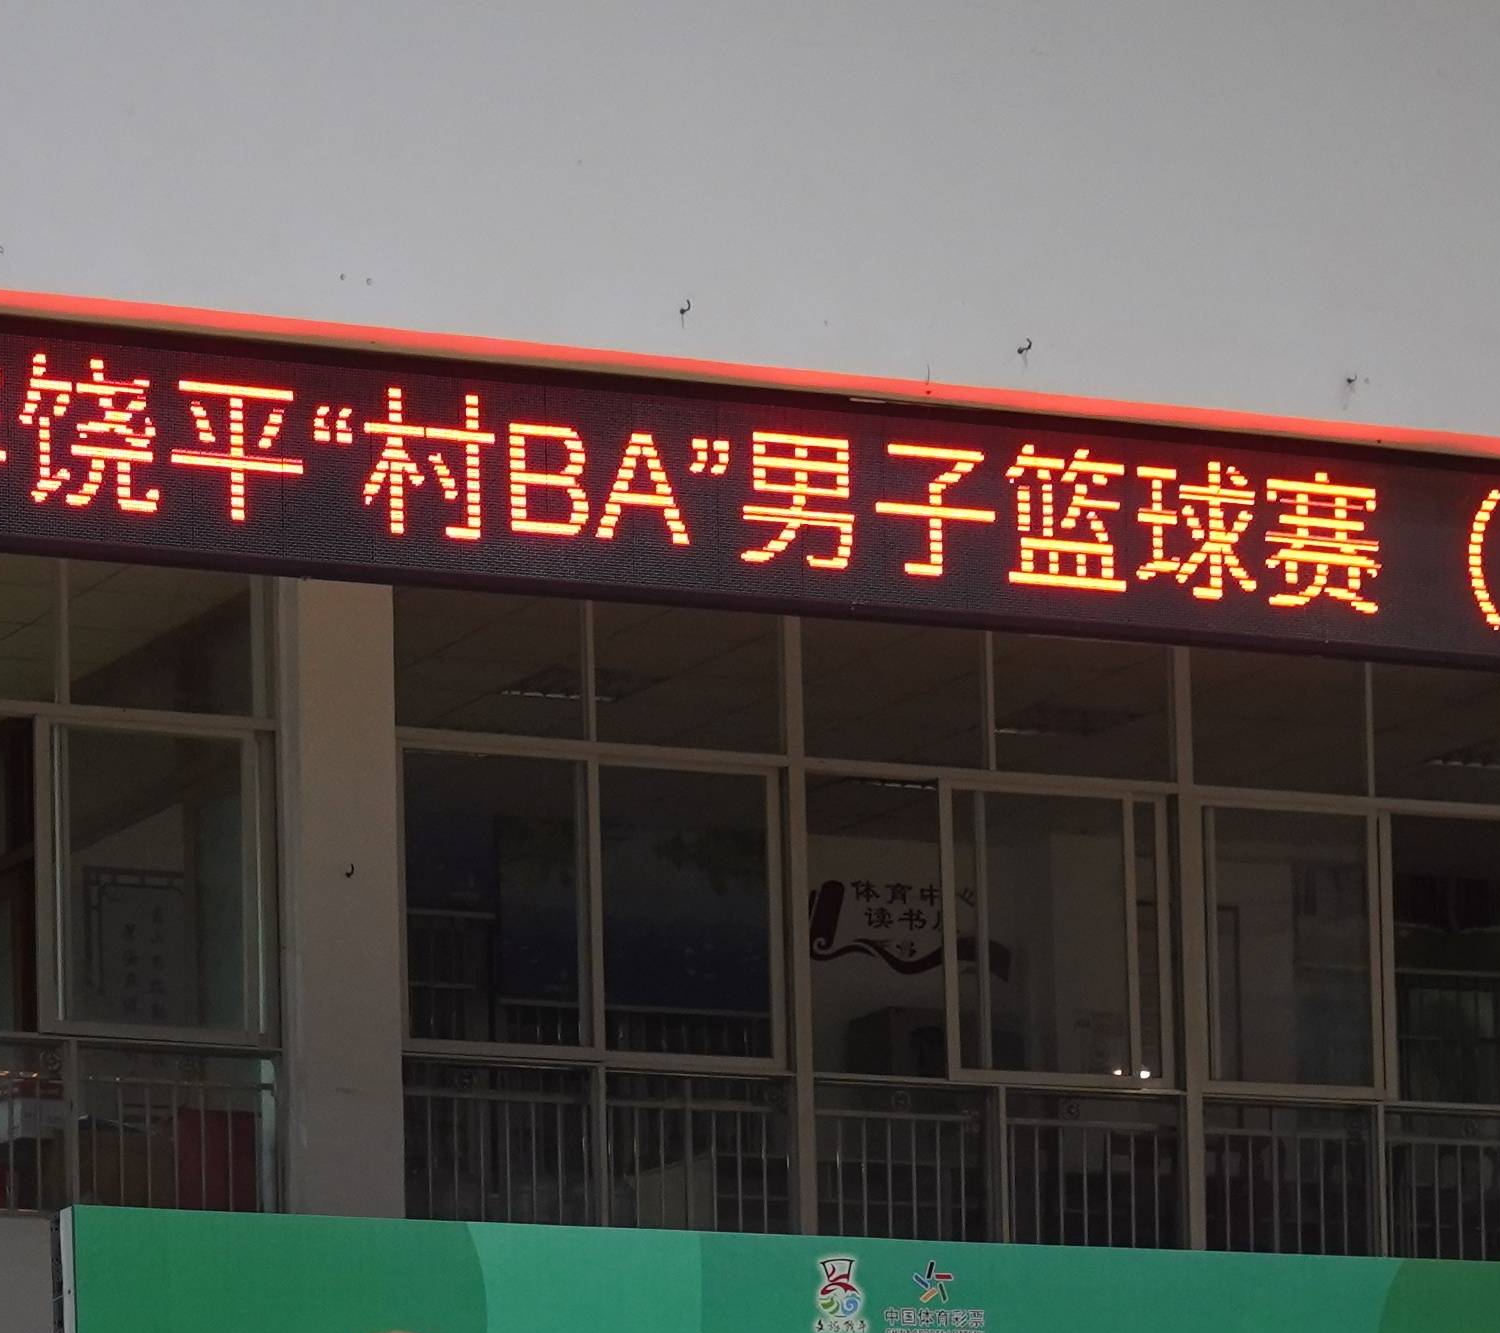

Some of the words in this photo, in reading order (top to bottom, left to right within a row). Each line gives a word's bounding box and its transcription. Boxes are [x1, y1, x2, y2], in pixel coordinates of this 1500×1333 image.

[884, 1307, 986, 1328] 中国体育彩票
